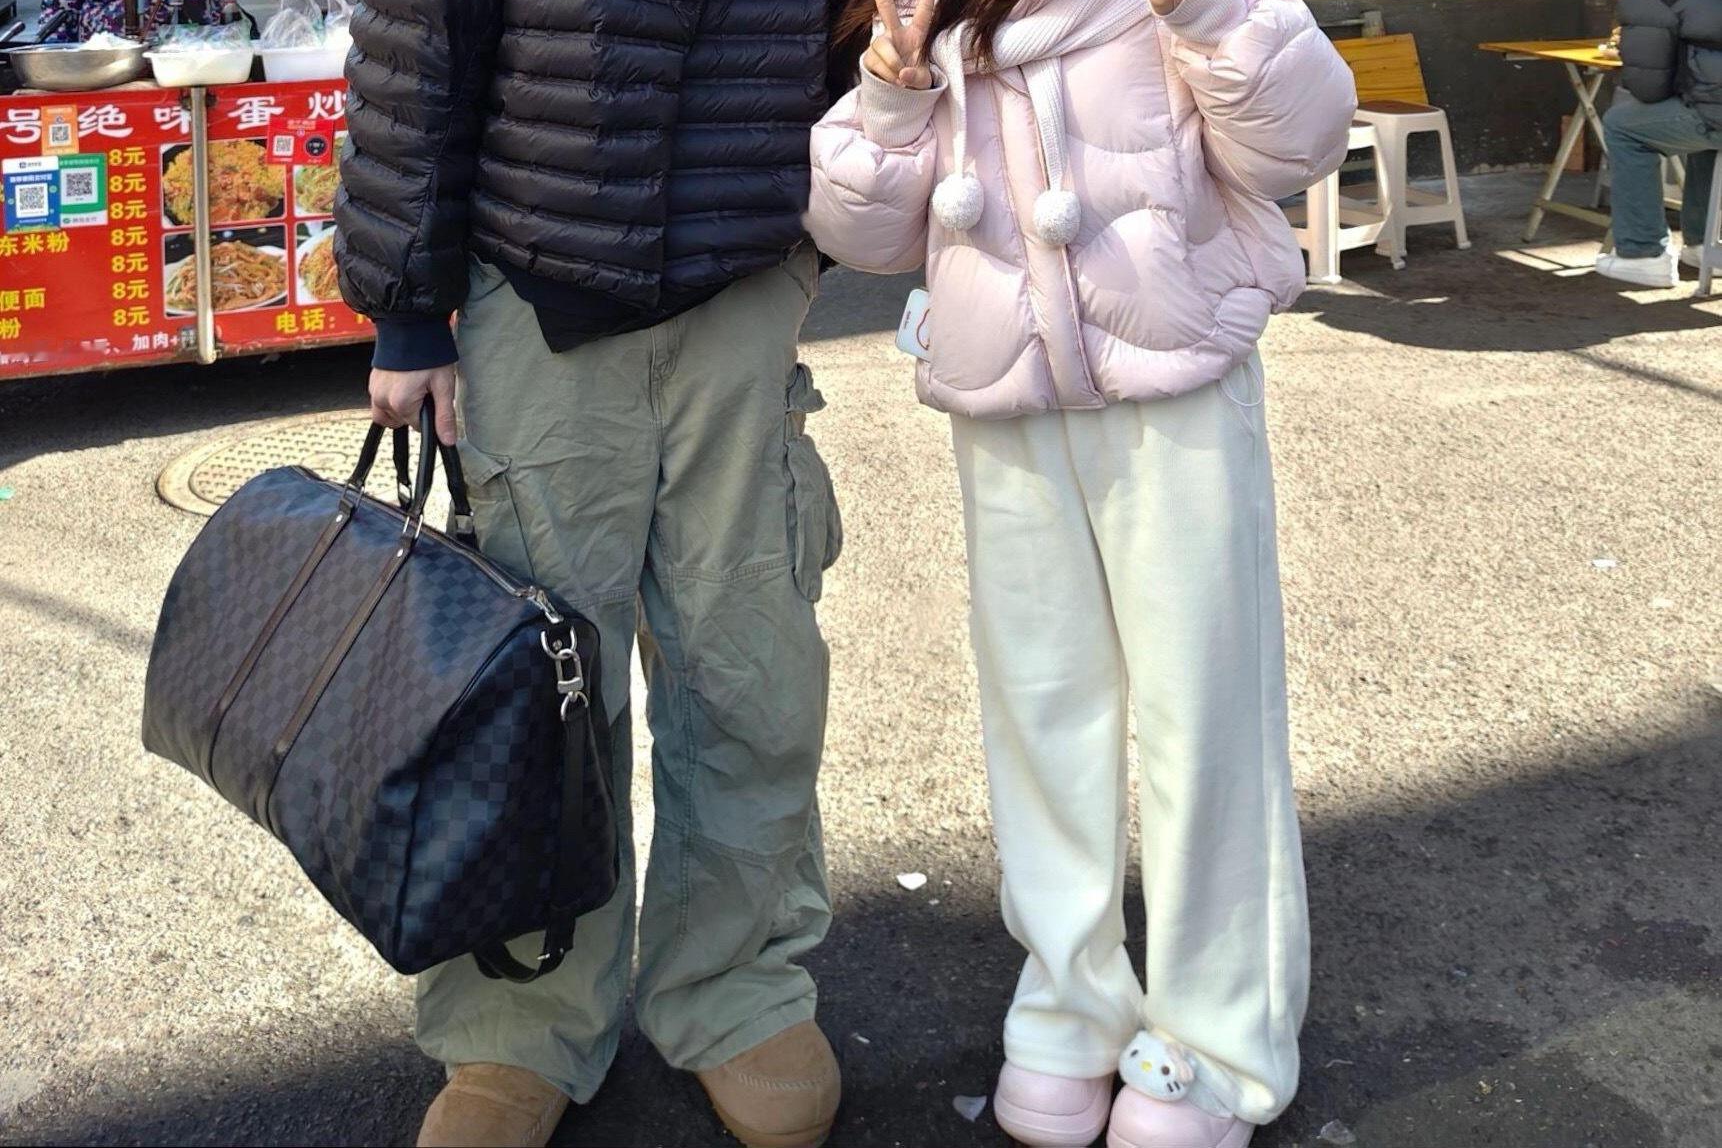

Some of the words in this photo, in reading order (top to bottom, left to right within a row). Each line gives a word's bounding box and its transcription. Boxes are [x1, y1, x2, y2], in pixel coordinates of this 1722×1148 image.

[109, 147, 147, 166] 8元
[109, 173, 147, 193] 8元
[110, 200, 148, 220] 8元
[111, 226, 148, 246] 8元
[112, 252, 149, 273] 8元
[112, 279, 150, 300] 8元
[113, 306, 150, 327] 8元
